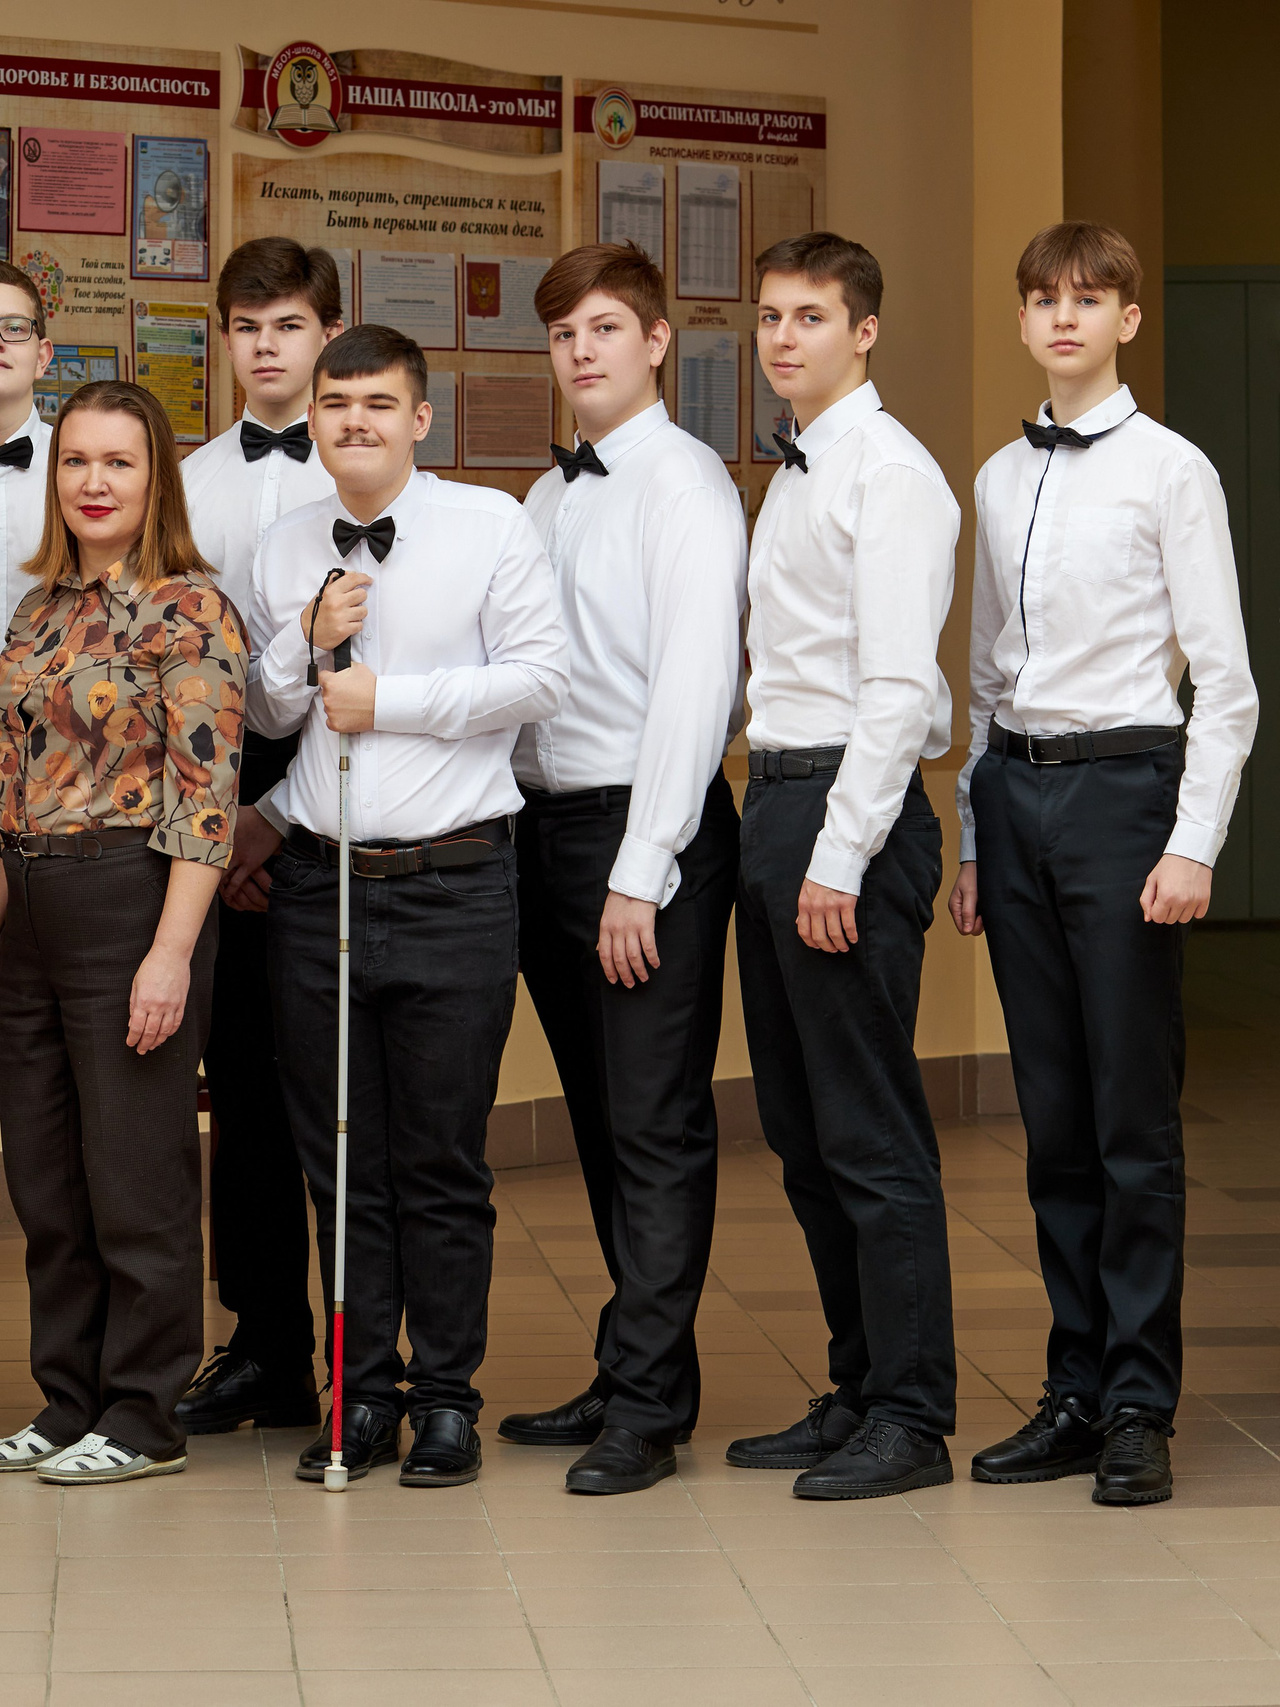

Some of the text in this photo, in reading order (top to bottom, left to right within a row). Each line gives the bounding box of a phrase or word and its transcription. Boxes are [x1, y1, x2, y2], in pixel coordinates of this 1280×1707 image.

[322, 57, 338, 82] №51
[73, 76, 86, 89] И
[89, 75, 211, 97] БЕЗОПАСНОСТЬ
[348, 85, 406, 108] НАША
[640, 104, 813, 131] ВОСПИТАТЕЛЬНАЯ РАБОТА
[650, 147, 799, 166] РАСПИСАНИЕ КРУЖКОВ И СЕКЦИЙ
[260, 181, 546, 216] Искать, творить, стремиться к цели,
[326, 210, 544, 238] Быть первыми во всяком деле.
[80, 257, 125, 270] Твой стиль
[65, 274, 126, 286] жизни сегодня,
[73, 288, 125, 302] Твое здоровье
[64, 305, 125, 317] и успех завтра!
[687, 316, 728, 326] ДЕЖУРСТВА
